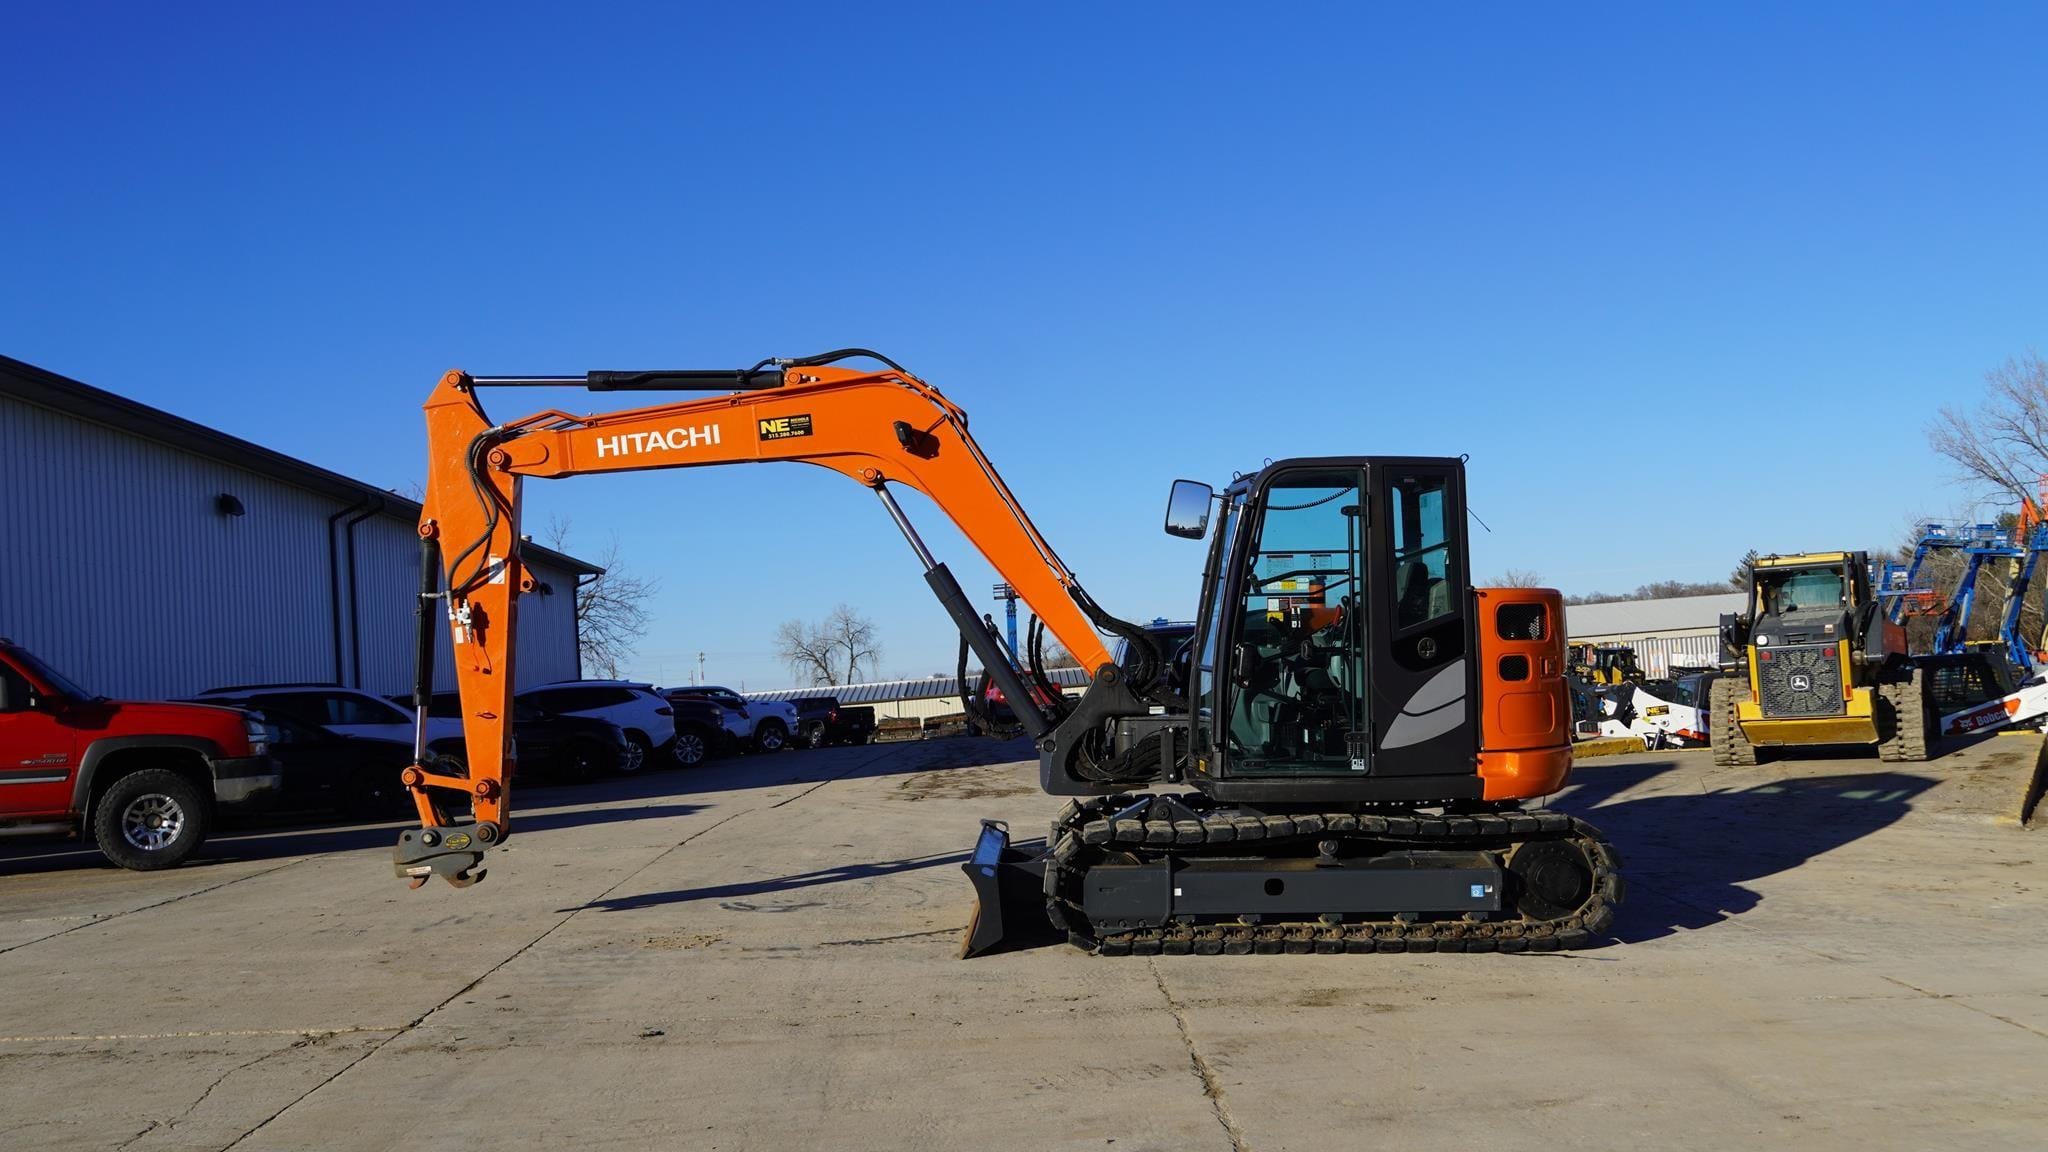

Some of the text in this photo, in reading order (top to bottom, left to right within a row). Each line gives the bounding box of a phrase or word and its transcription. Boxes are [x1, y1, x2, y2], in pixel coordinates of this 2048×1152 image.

[761, 418, 790, 434] NE
[597, 424, 720, 458] HITACHI
[1976, 708, 2012, 726] Bobcat
